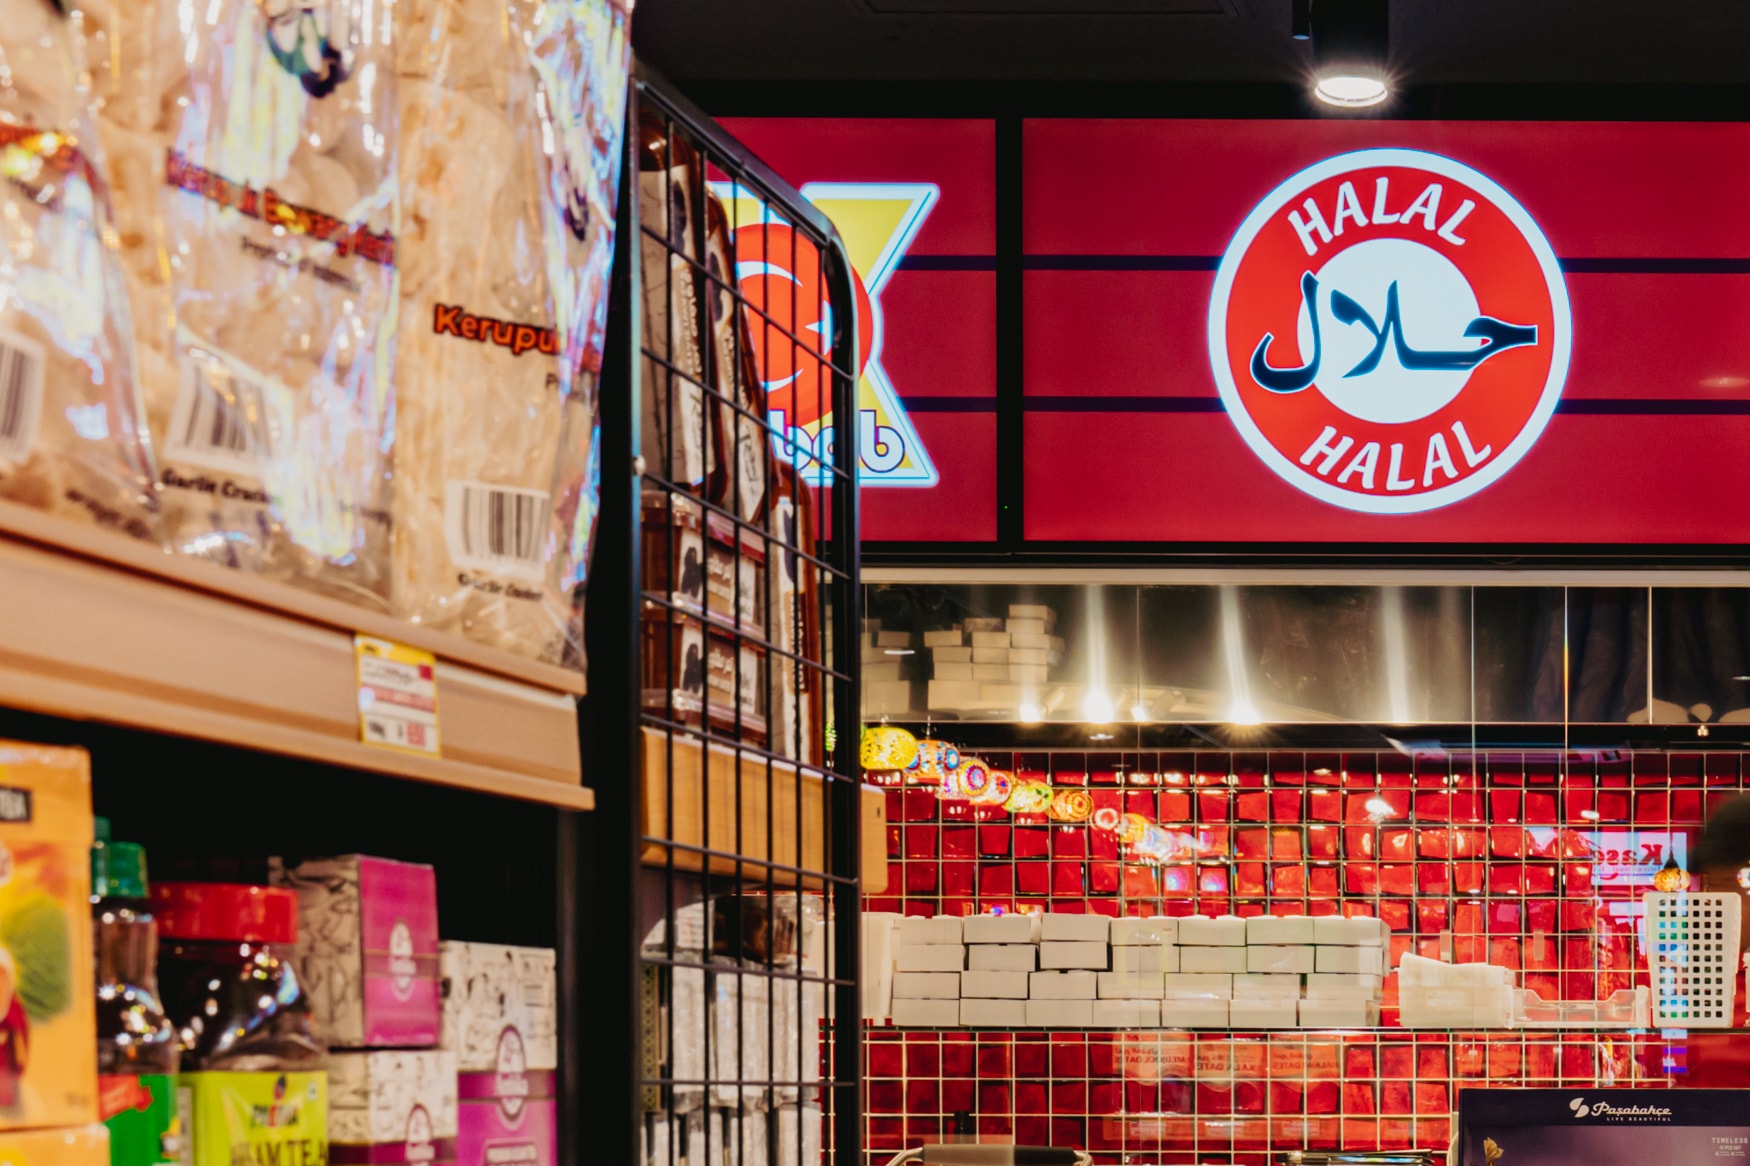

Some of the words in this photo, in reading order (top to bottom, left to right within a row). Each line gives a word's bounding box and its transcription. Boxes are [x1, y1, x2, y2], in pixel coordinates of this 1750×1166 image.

[1288, 177, 1477, 257] HALAL
[433, 303, 566, 357] Kerupu
[1250, 270, 1538, 394] حلال
[1300, 420, 1492, 491] HALAL
[1591, 1101, 1672, 1117] Paşabahçe
